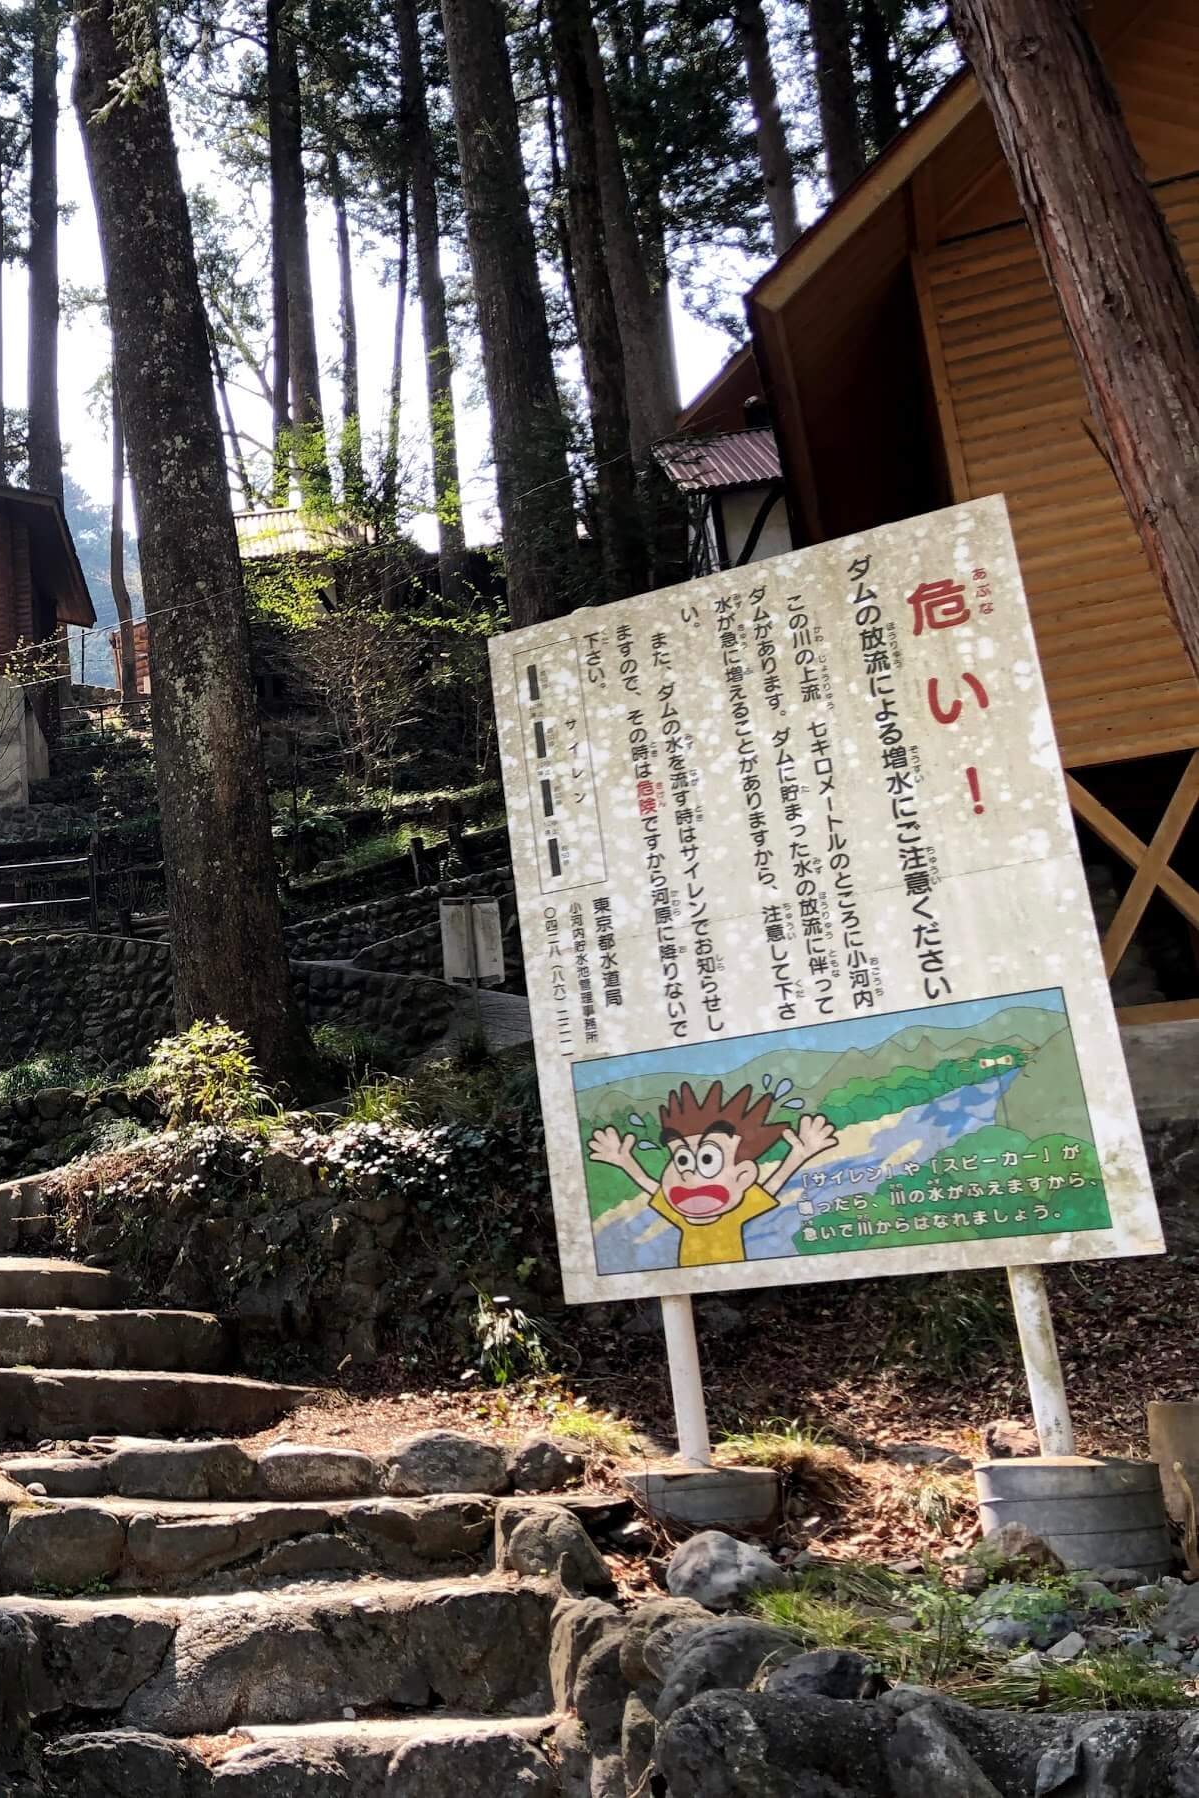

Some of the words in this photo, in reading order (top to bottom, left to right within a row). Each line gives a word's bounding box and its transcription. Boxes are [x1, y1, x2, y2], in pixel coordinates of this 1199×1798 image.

[971, 567, 994, 615] あぶな
[583, 632, 607, 688] 下さい。
[565, 719, 586, 804] サイレン
[847, 554, 952, 1000] ダムの放流による増水にご注意ください
[569, 901, 599, 1043] 小河内貯水池管理事務所
[593, 897, 623, 1008] 東京都水道局
